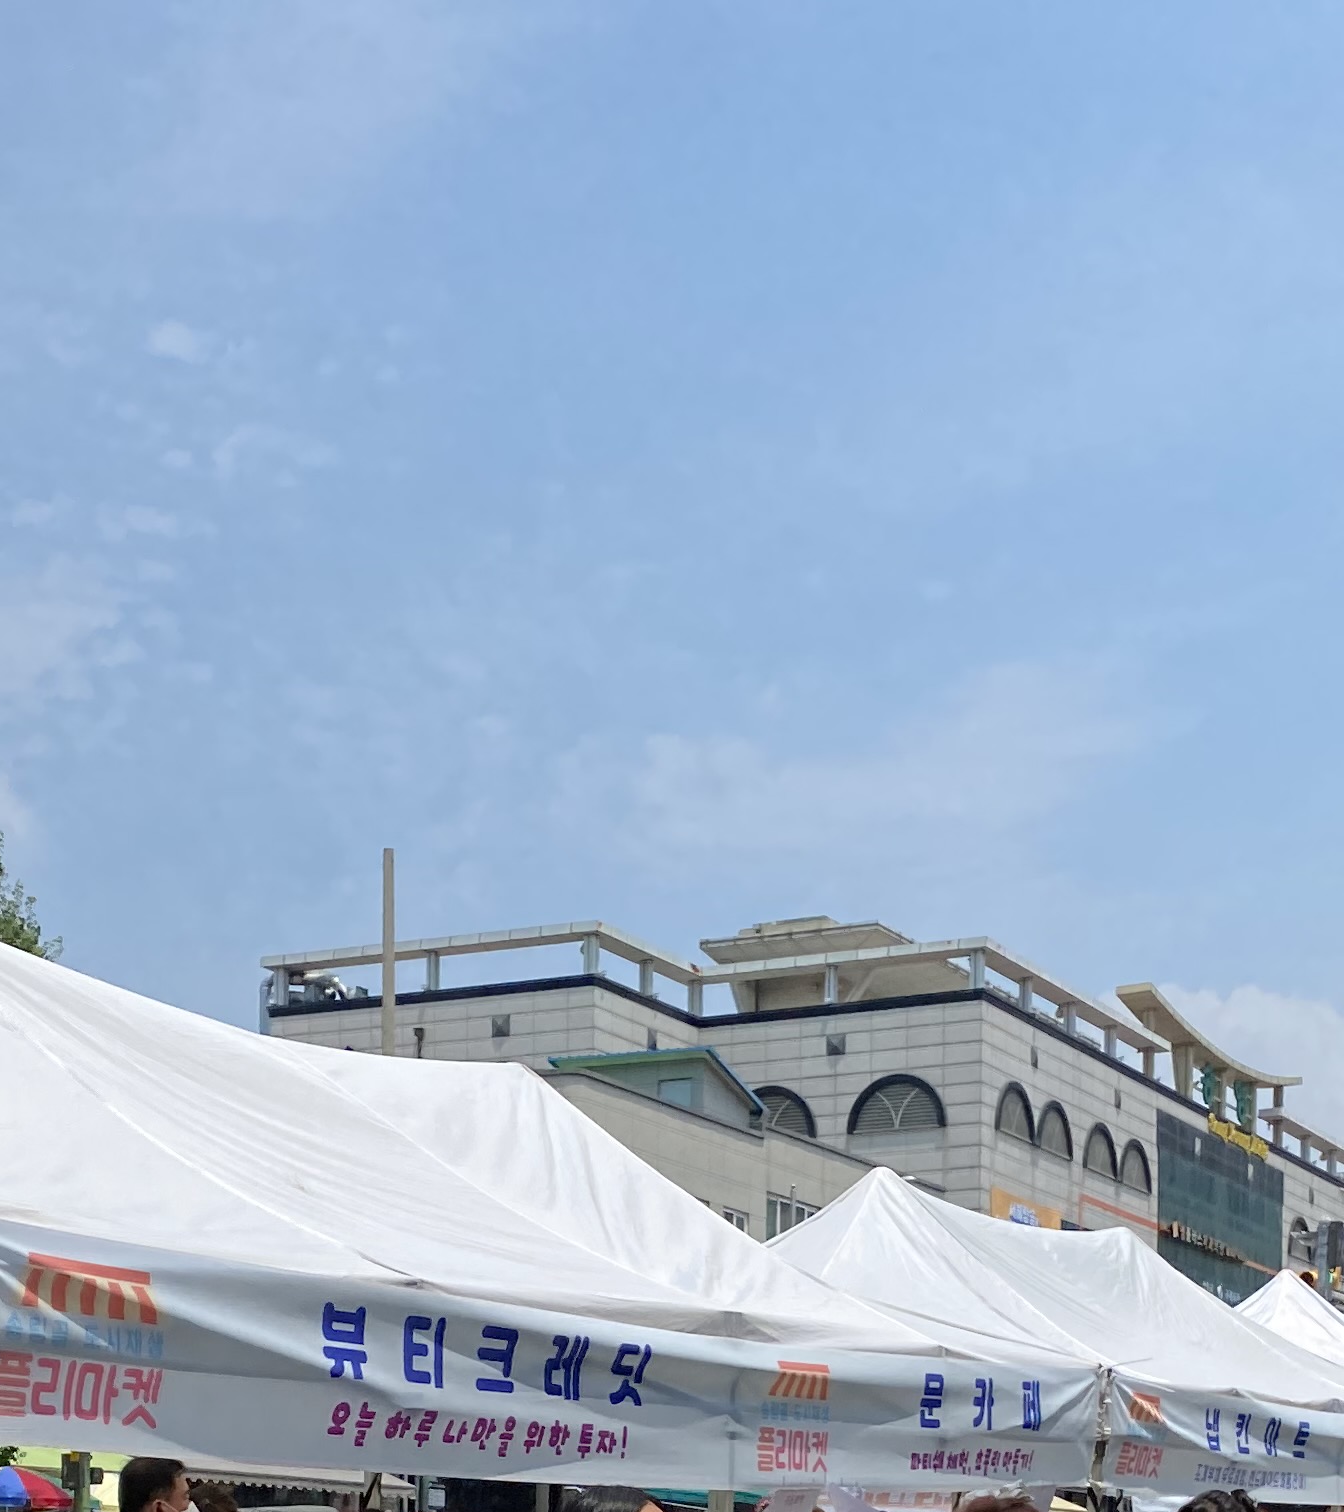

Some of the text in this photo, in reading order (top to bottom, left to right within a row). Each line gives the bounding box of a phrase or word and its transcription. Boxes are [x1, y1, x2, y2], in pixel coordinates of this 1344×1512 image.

[327, 1402, 628, 1459] 오늘 하루 나만을 위한 투자!
[757, 1426, 829, 1473] 플리마켓
[1115, 1441, 1164, 1479] 플리마켓
